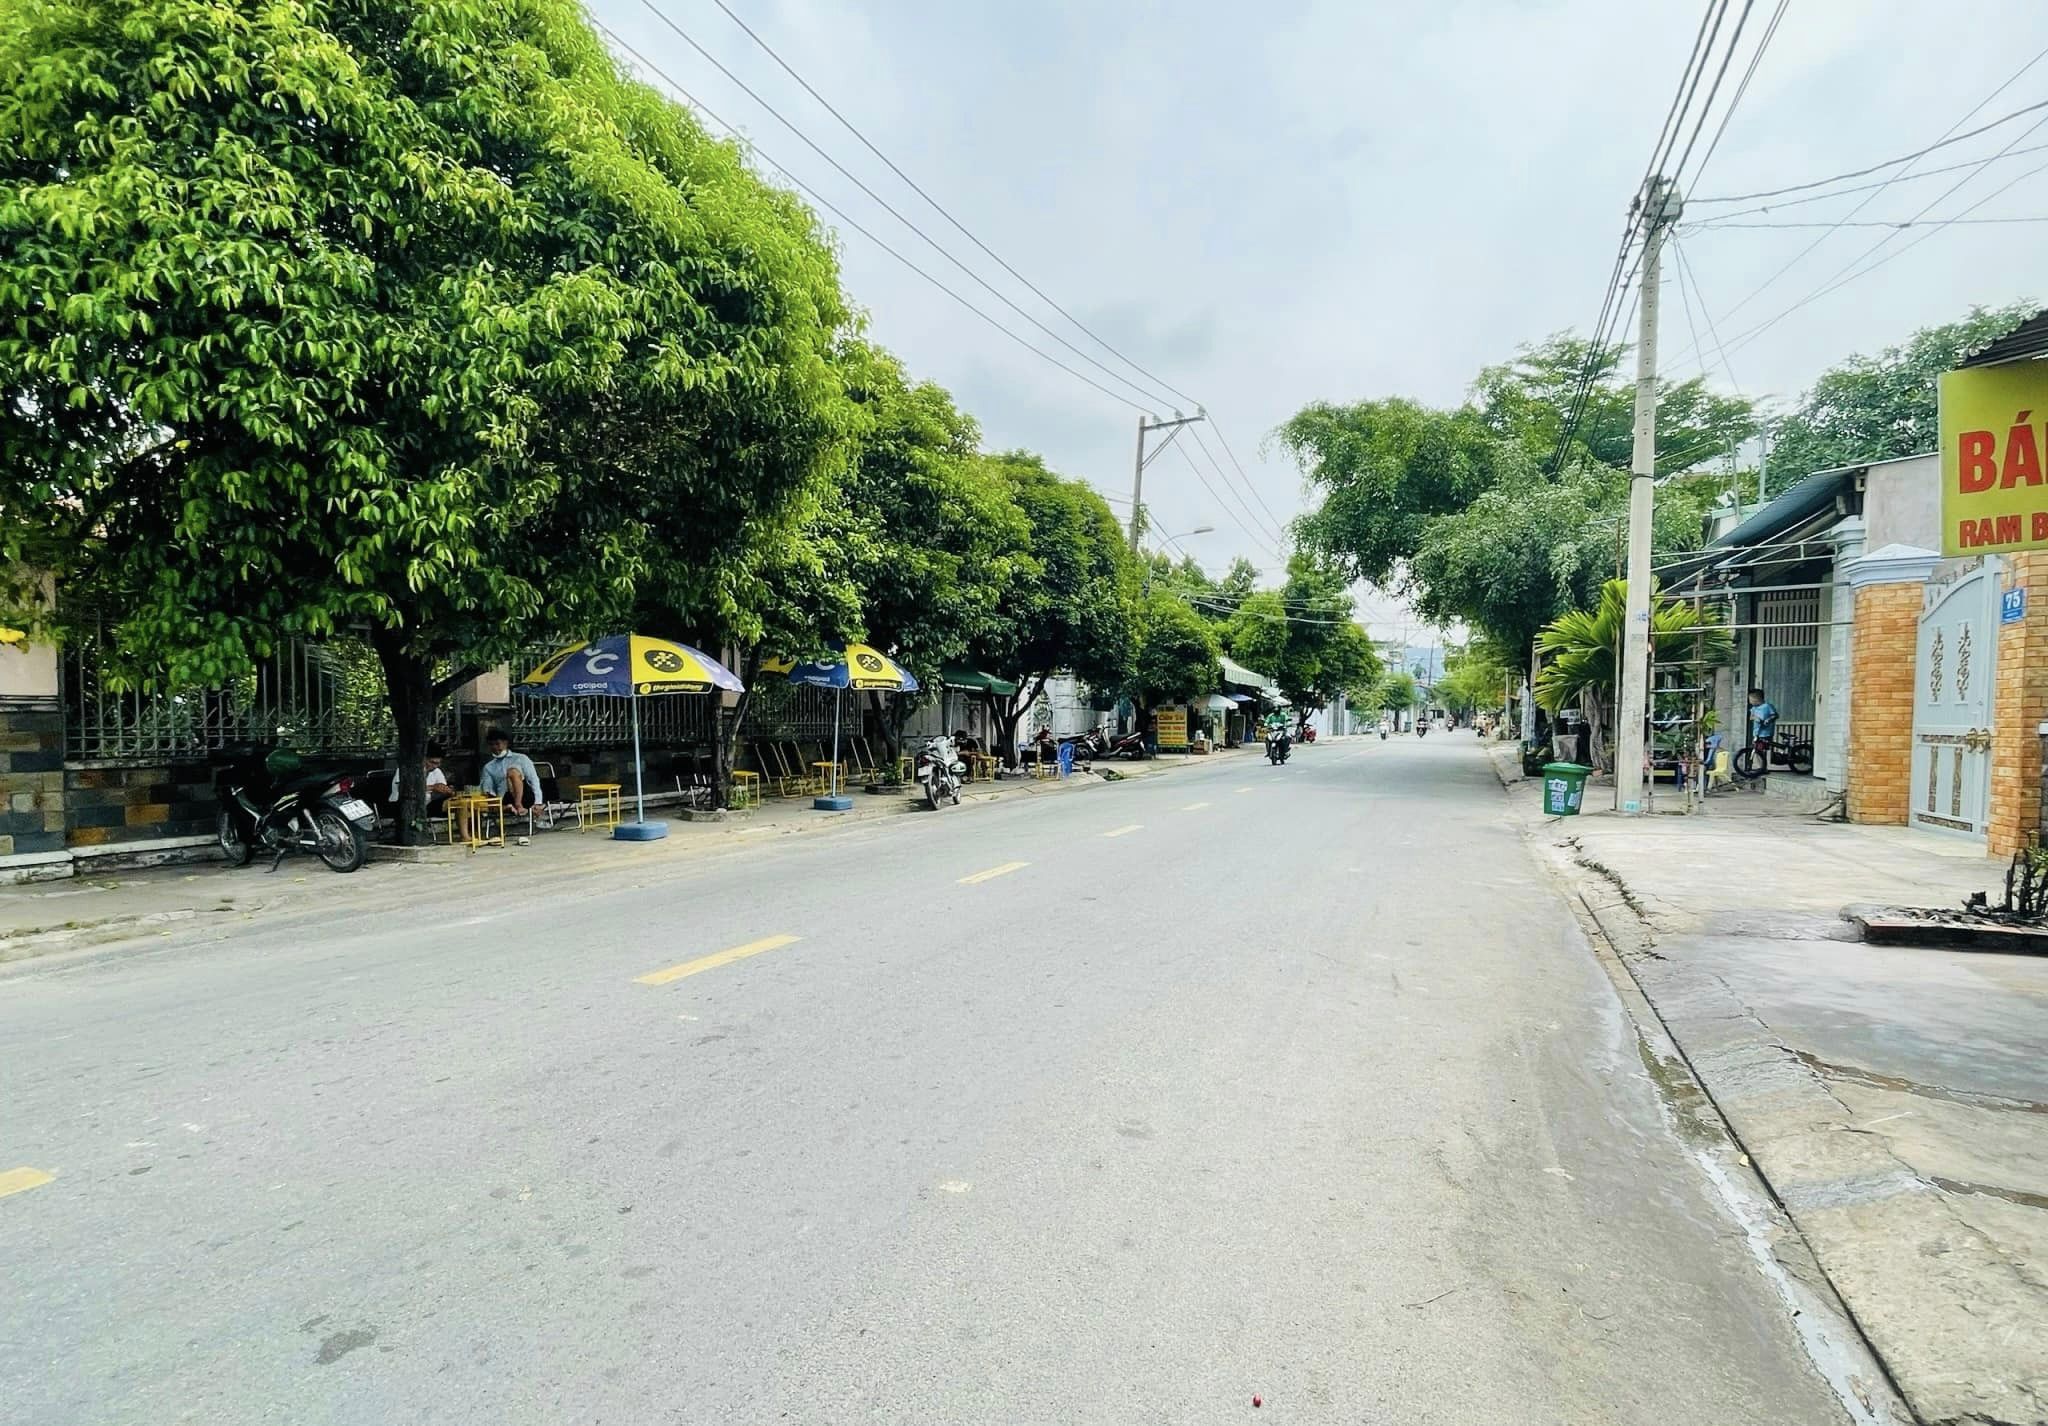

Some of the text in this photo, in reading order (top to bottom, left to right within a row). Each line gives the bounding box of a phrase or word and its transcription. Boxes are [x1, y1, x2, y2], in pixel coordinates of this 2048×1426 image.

[1959, 410, 2048, 494] BÁ
[1959, 515, 2022, 548] RAM
[2005, 591, 2020, 609] 75
